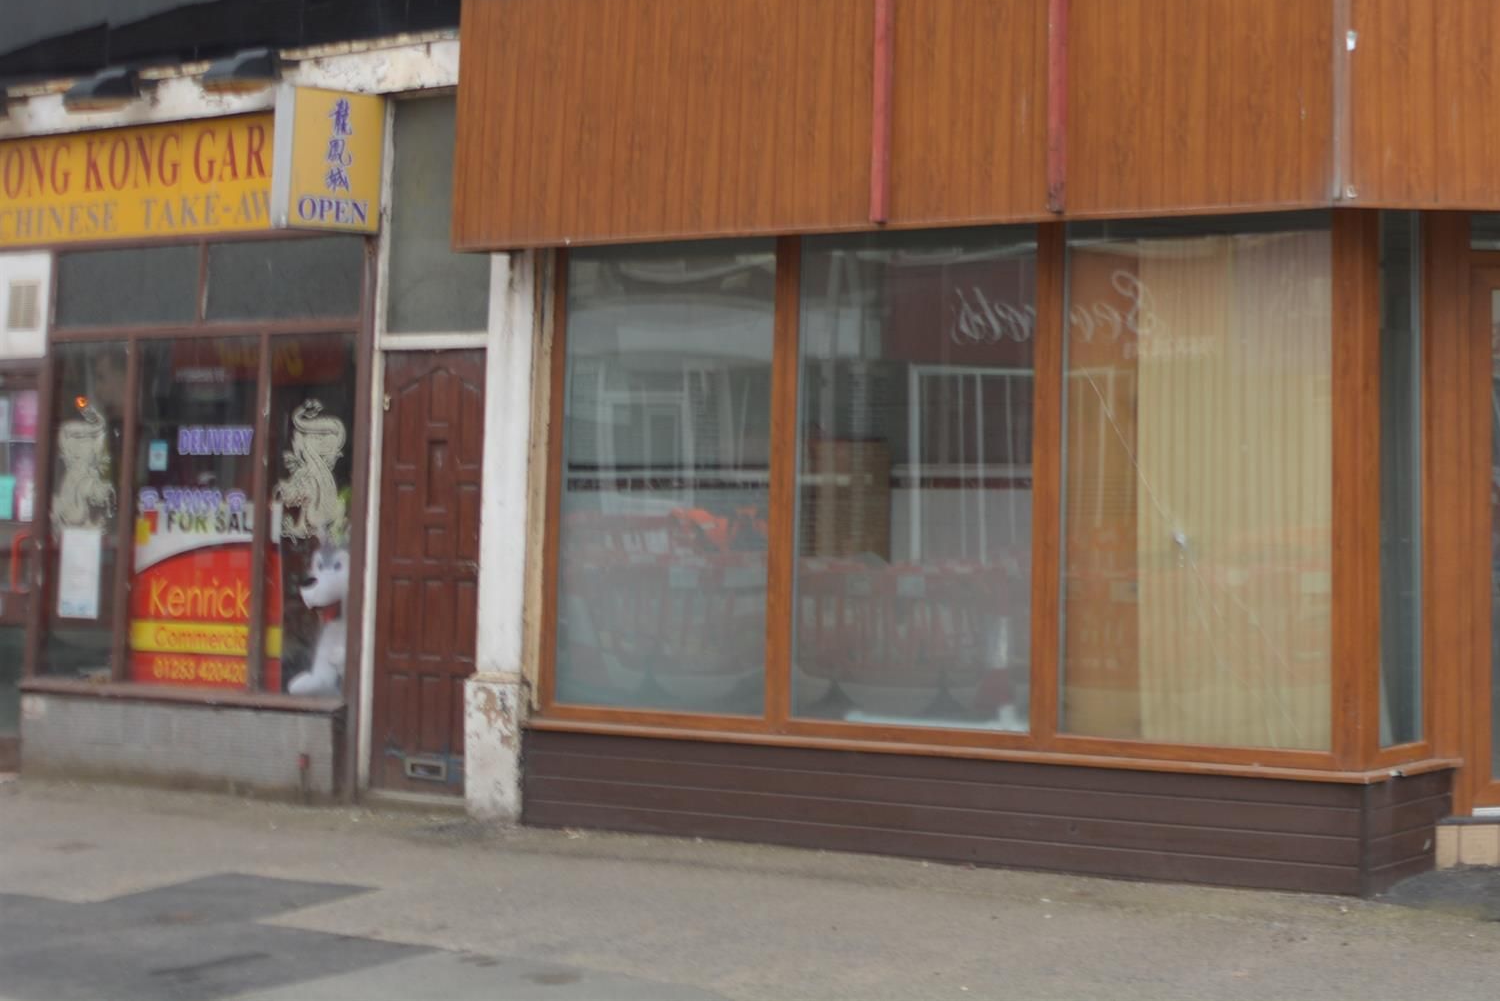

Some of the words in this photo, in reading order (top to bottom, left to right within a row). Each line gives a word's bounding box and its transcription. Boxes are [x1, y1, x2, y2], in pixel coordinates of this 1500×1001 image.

[1, 140, 72, 200] ONG
[84, 132, 181, 193] KONG
[193, 123, 273, 185] GAR
[141, 188, 271, 231] TAKE-AW
[298, 198, 369, 225] OPEN
[178, 426, 254, 456] DELIVERY
[167, 510, 208, 533] FOR
[215, 510, 253, 534] SAL
[155, 625, 247, 648] Commercia
